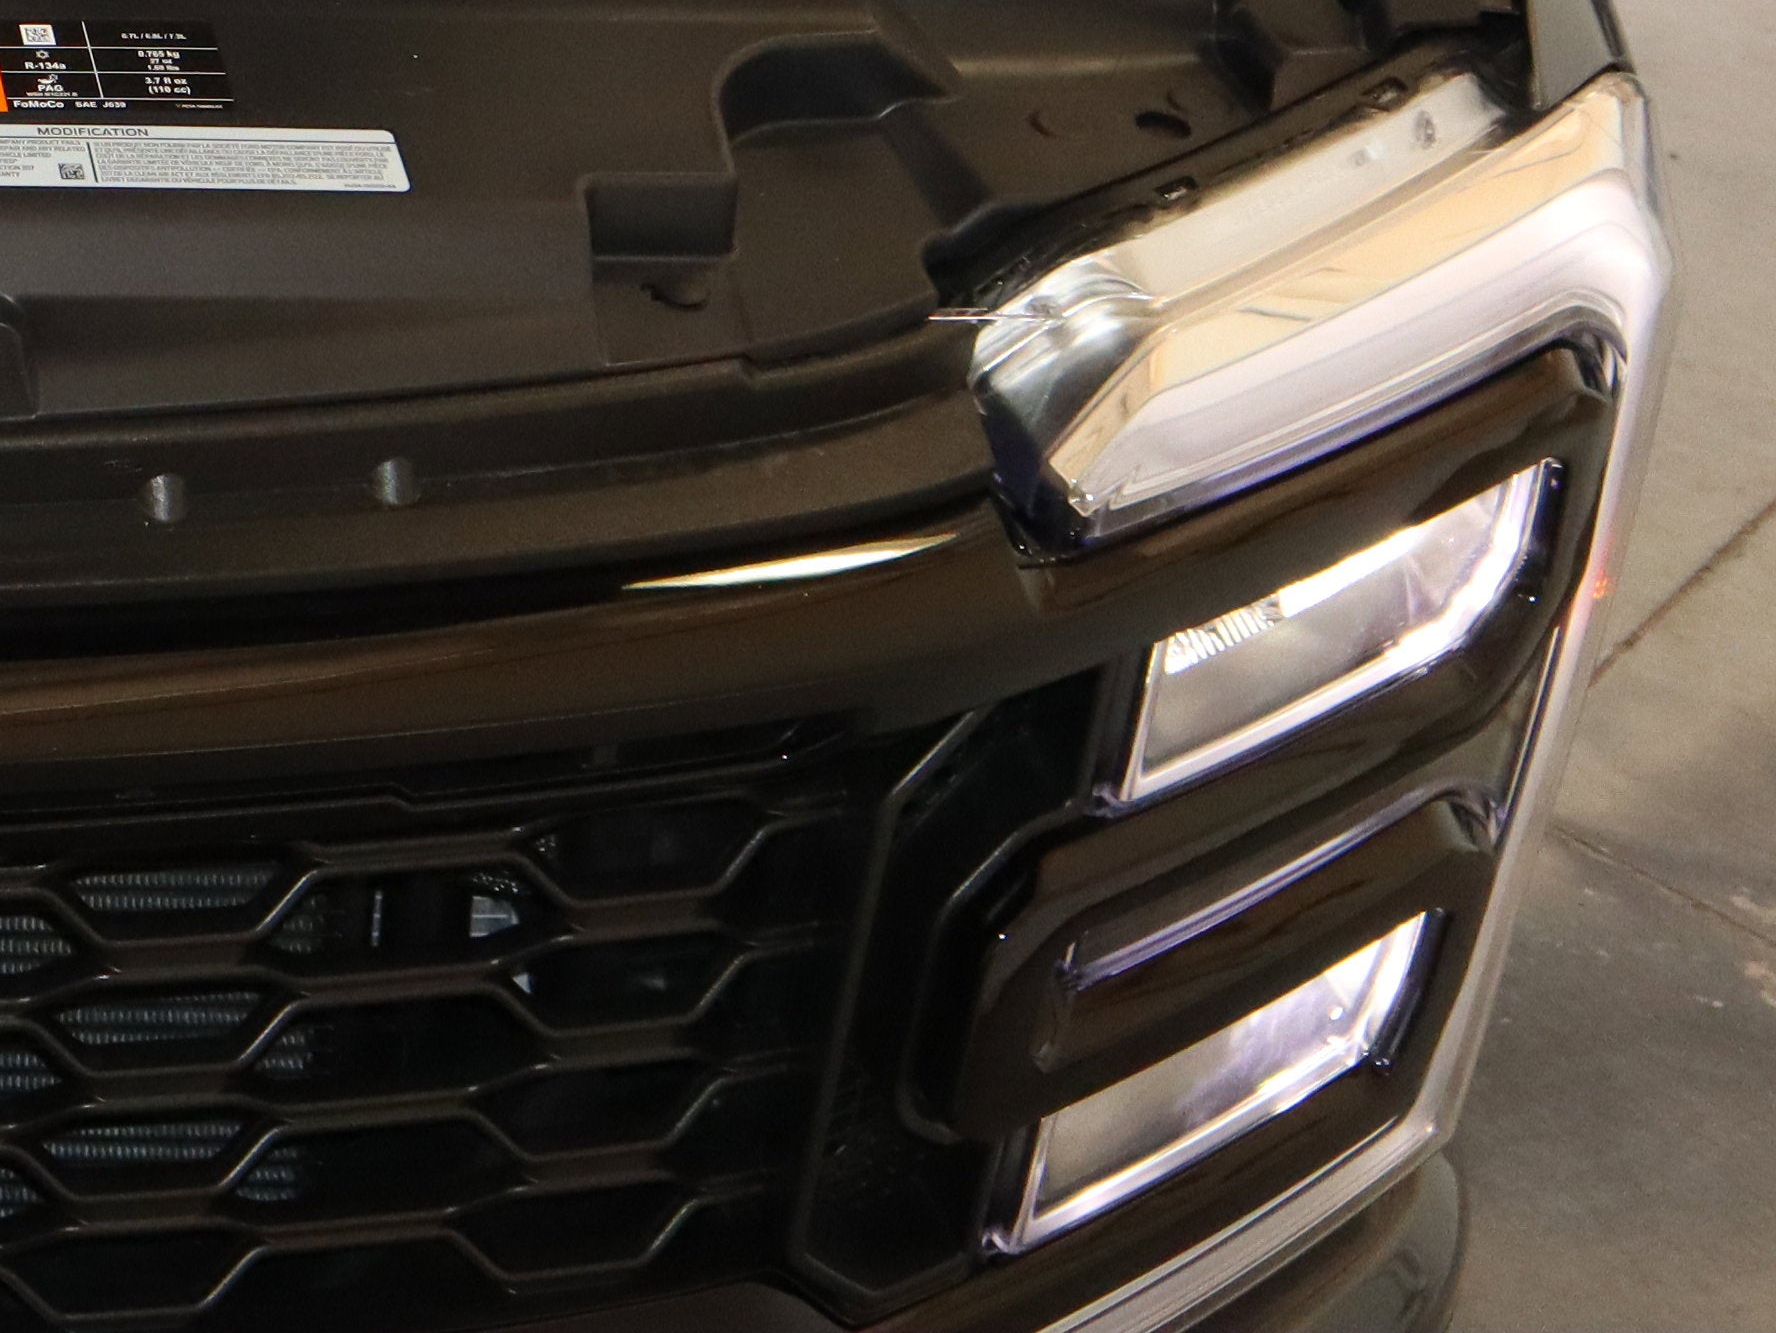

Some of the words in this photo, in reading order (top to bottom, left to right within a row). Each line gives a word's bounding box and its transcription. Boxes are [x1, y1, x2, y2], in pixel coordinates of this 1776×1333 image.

[166, 50, 180, 59] kg
[24, 61, 66, 70] R-134a
[144, 77, 160, 85] 3.7
[37, 84, 64, 92] PAG
[148, 85, 171, 95] (110
[173, 85, 191, 96] cc)
[13, 100, 65, 108] FoMoCo
[37, 126, 149, 137] MODIFICATION
